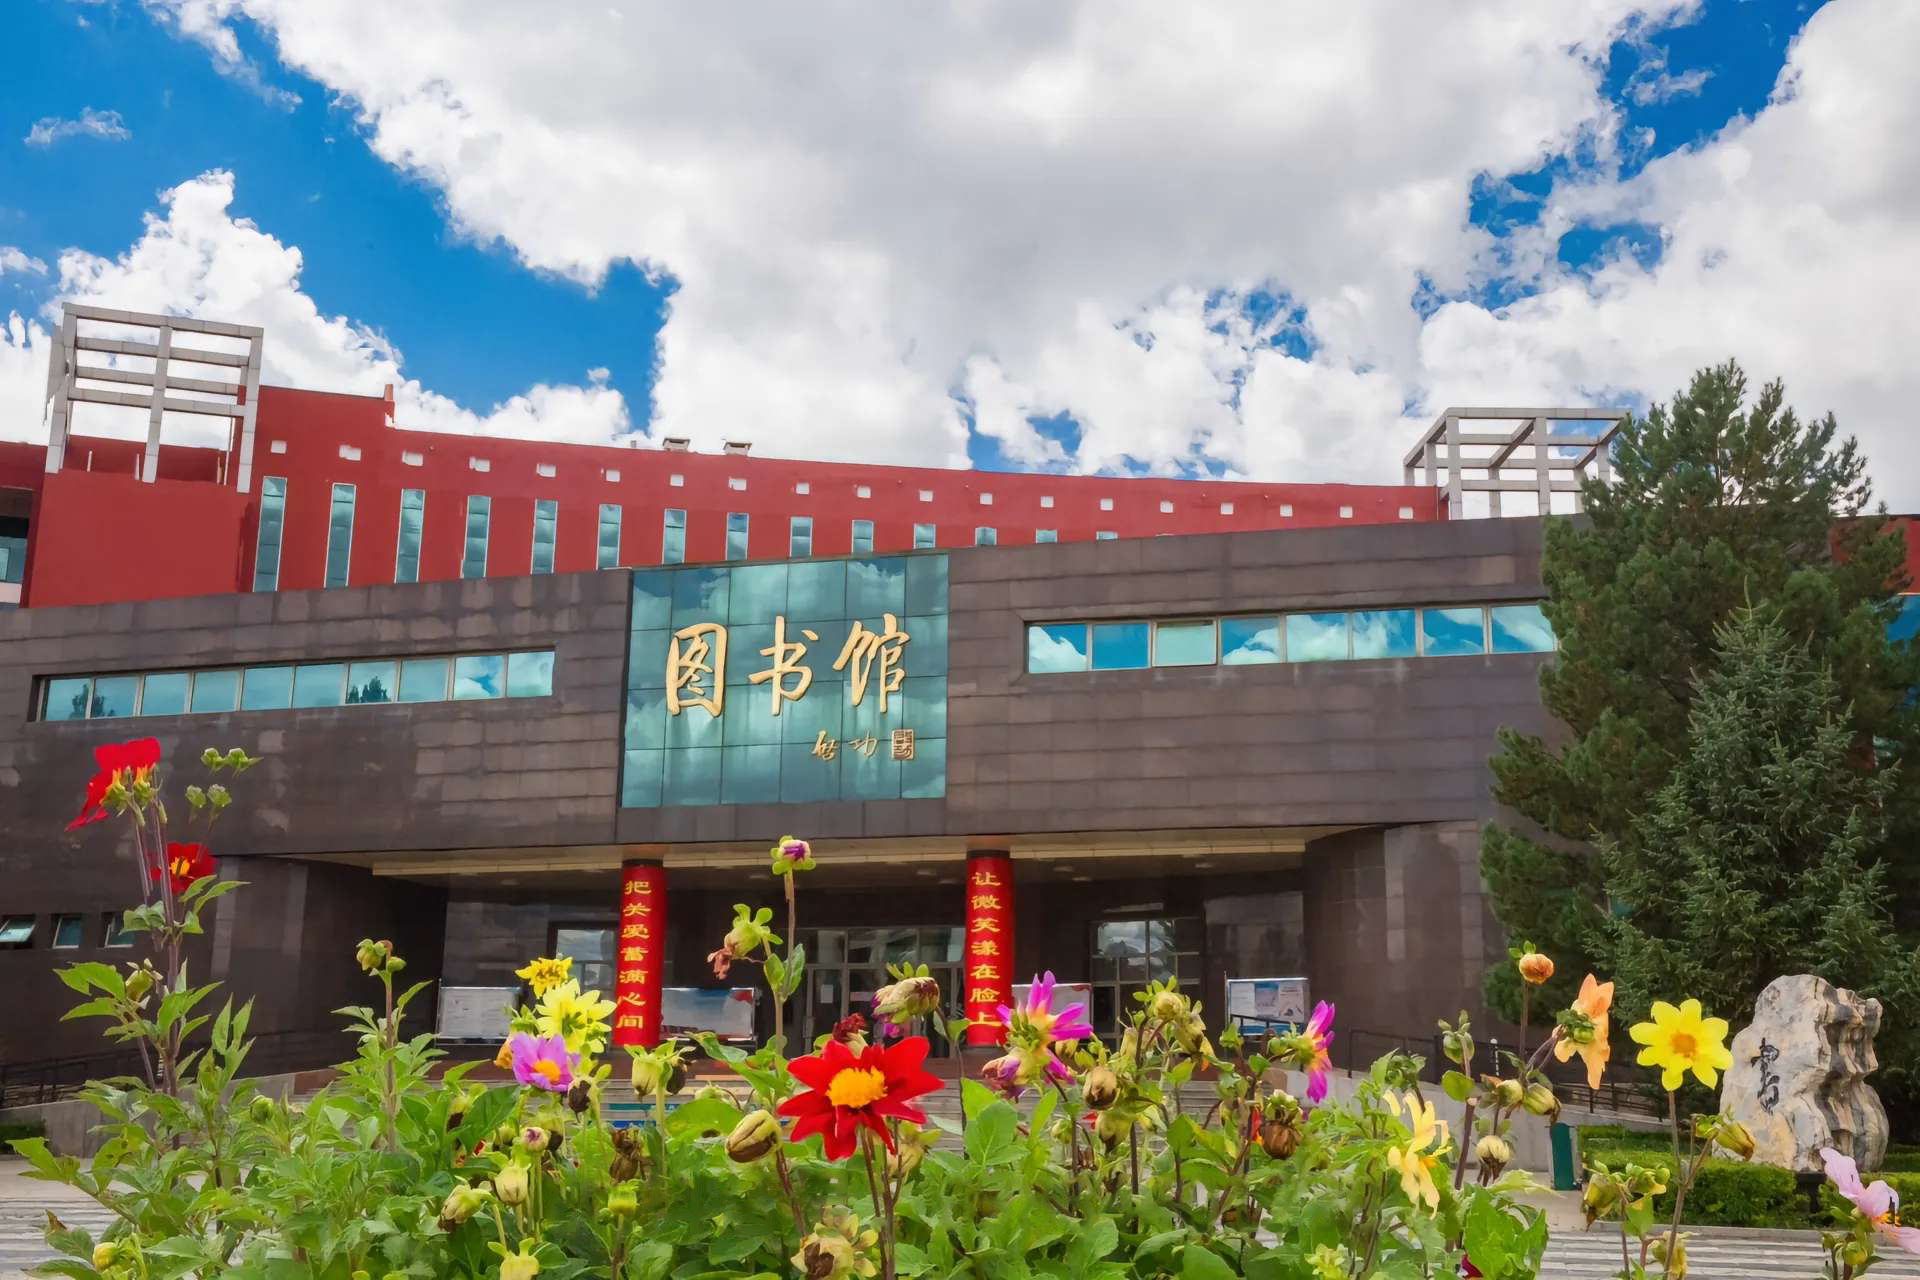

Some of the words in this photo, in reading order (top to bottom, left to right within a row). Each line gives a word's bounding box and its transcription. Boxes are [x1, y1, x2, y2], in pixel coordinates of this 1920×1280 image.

[666, 613, 910, 718] 图书馆
[968, 871, 1003, 1027] 让微笑漾在脸上
